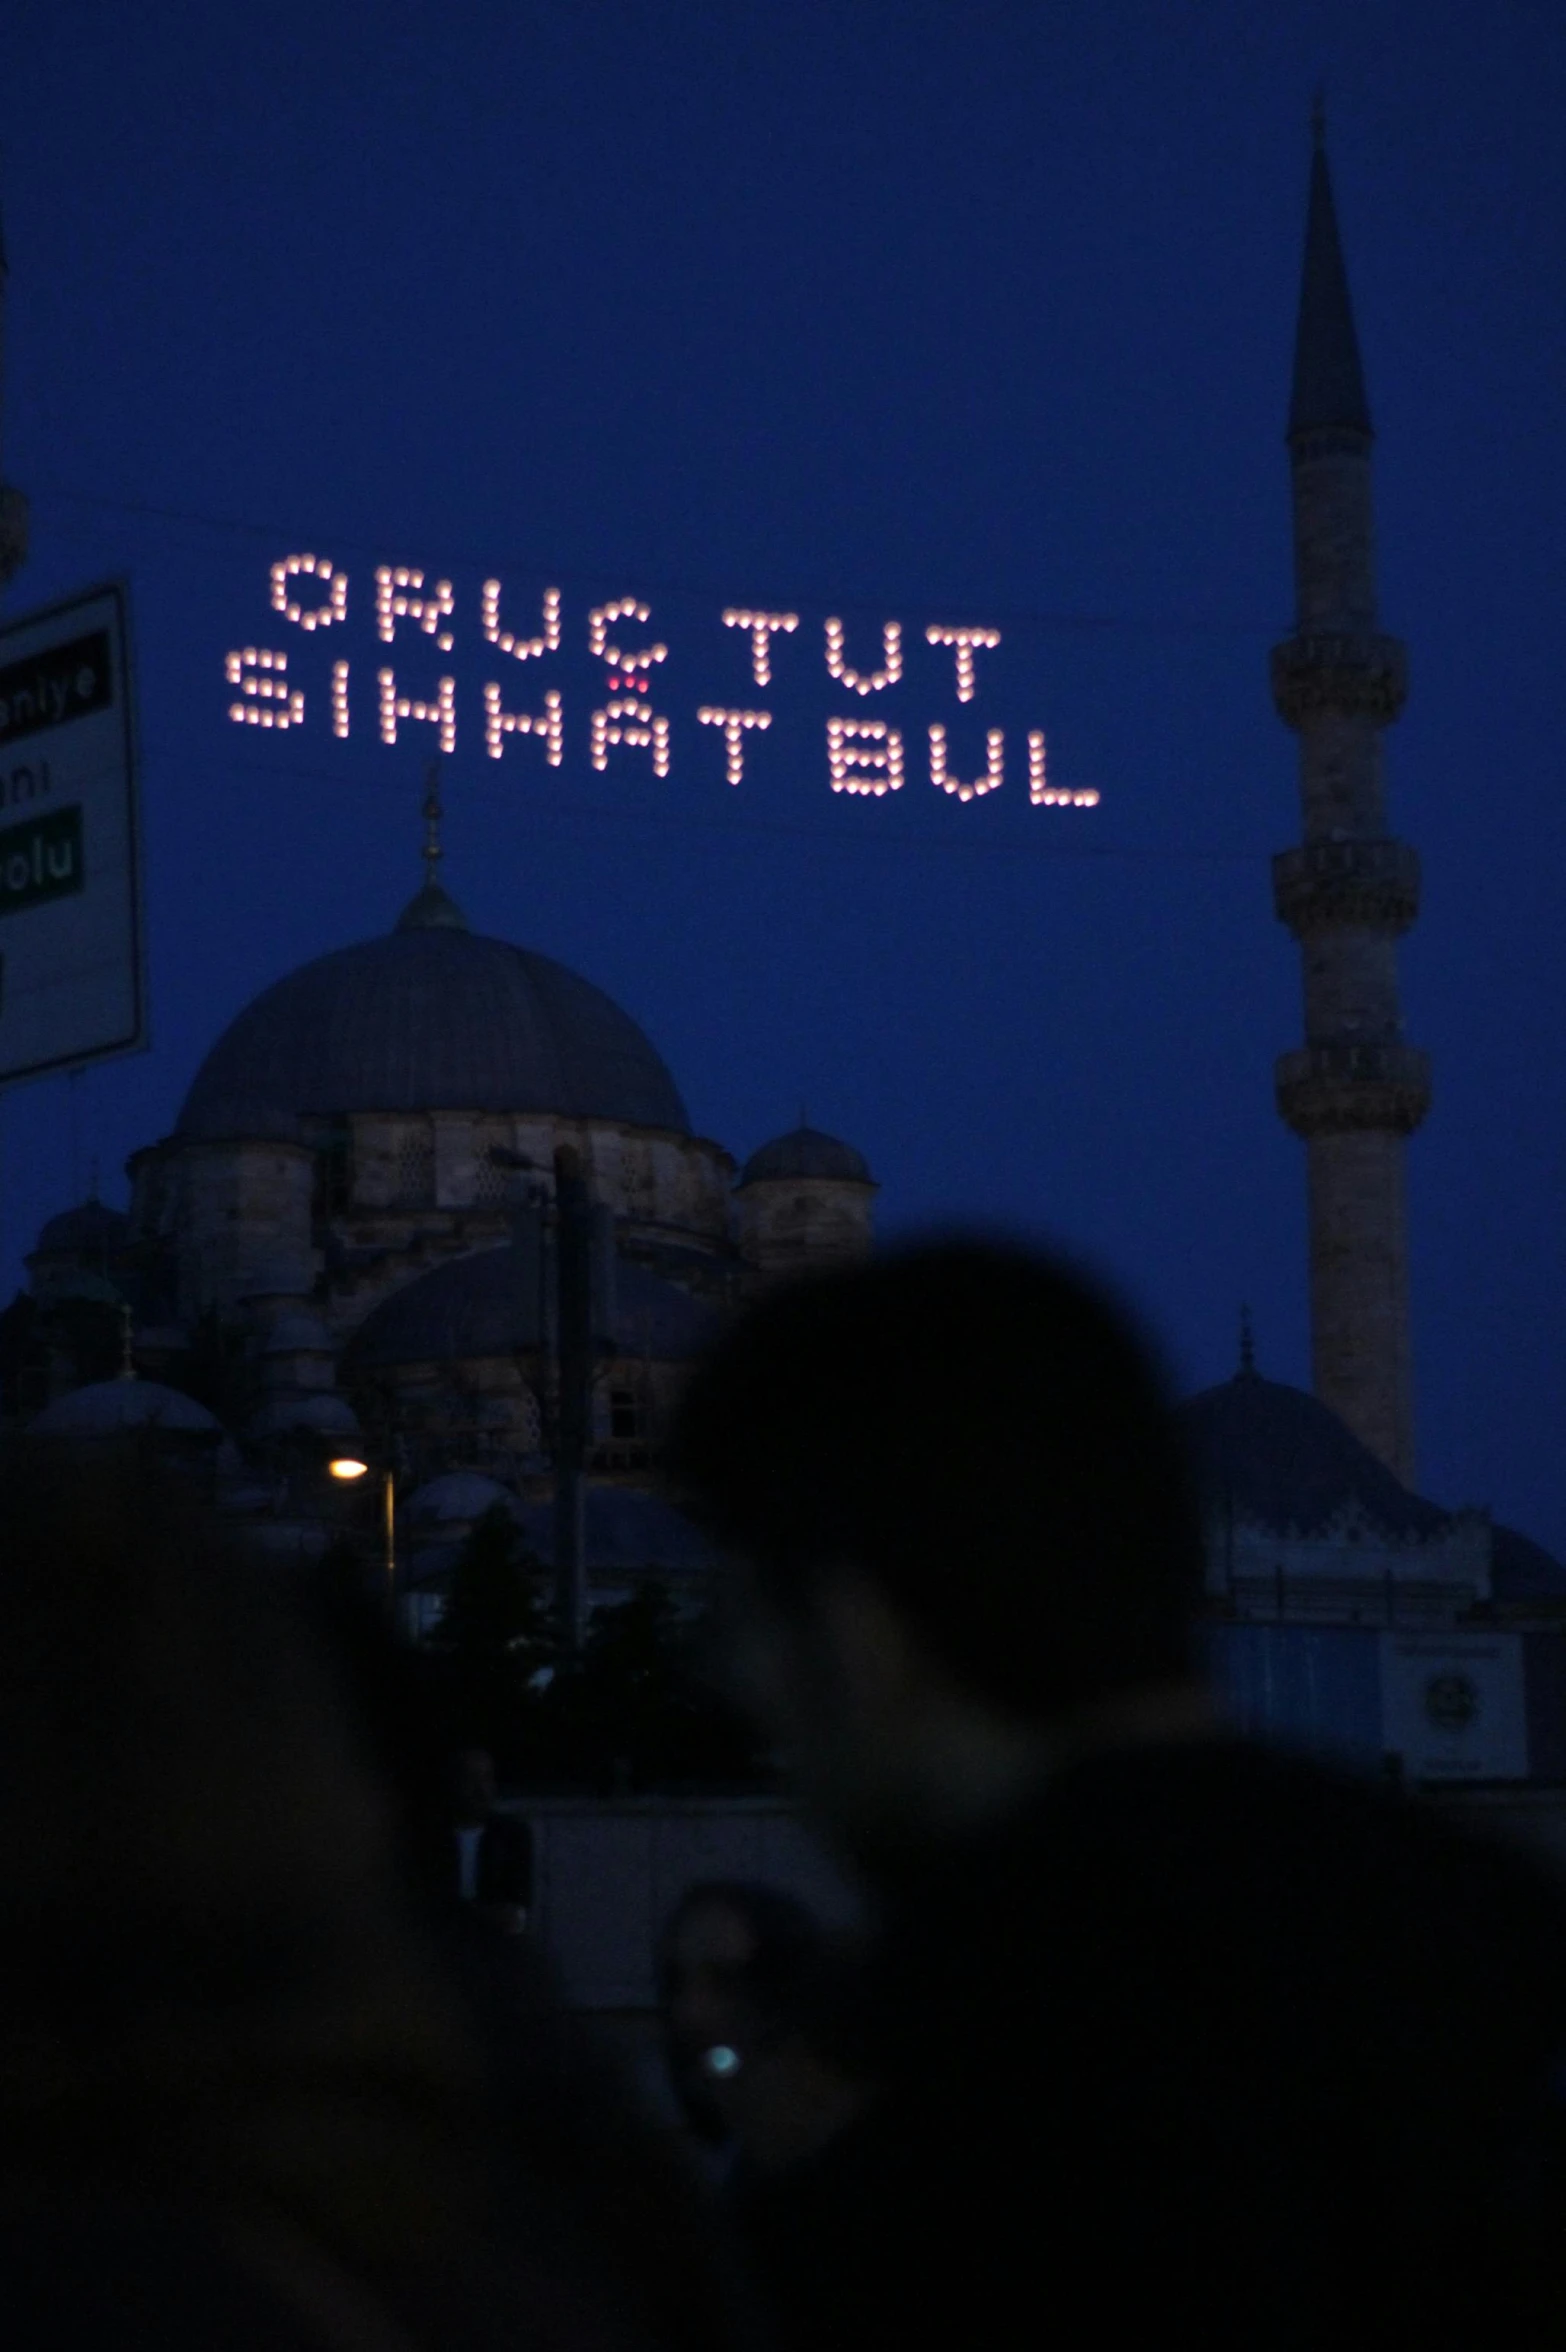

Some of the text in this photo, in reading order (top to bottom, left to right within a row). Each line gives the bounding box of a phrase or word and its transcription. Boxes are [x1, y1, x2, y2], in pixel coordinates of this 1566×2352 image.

[270, 552, 1004, 704] ORUÇ TUT
[225, 646, 1102, 808] SIHHAT BUL
